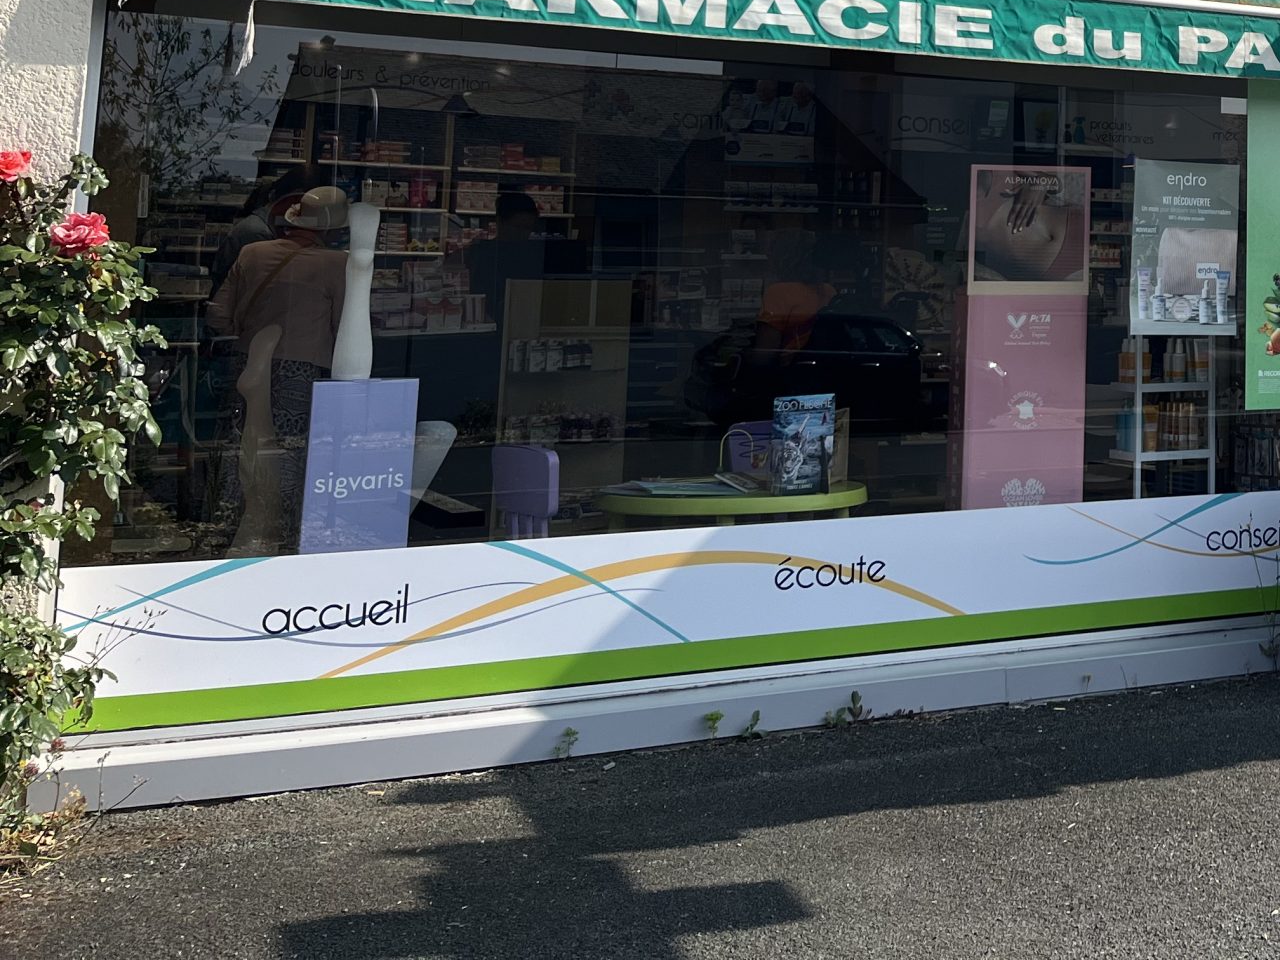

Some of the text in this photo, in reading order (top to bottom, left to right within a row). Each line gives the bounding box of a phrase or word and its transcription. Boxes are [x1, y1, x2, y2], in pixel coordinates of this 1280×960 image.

[1034, 15, 1142, 61] du
[400, 68, 491, 91] prévention
[1005, 176, 1059, 185] ALPHANOVA
[1162, 195, 1211, 207] KIT DÉCOUVERTE
[777, 401, 798, 412] ZOO
[314, 467, 405, 499] sigvaris
[773, 554, 887, 592] écoute
[262, 583, 410, 636] accueil
